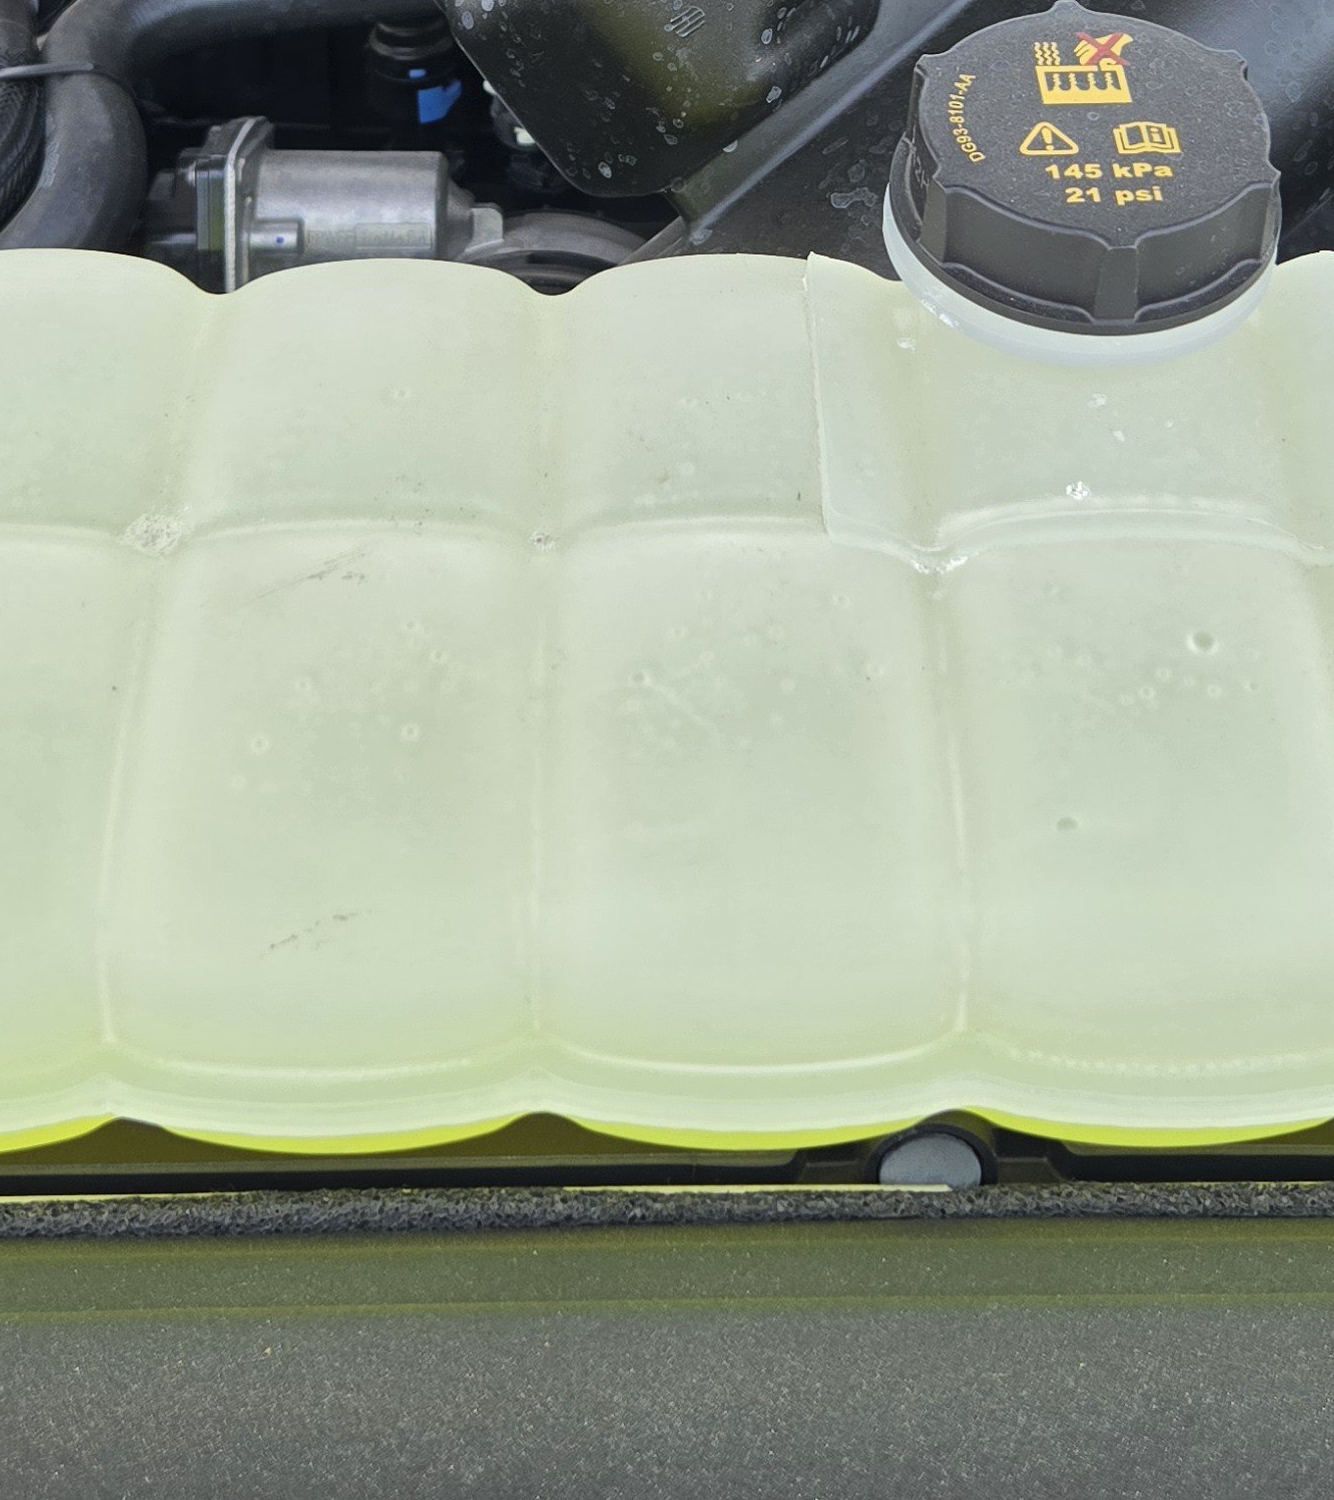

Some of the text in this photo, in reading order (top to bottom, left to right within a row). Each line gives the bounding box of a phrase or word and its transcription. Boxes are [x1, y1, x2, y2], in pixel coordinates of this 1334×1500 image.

[947, 73, 987, 163] DG93-8101-AA
[1044, 162, 1174, 180] 145 kPa
[1064, 185, 1164, 206] 21 psi
